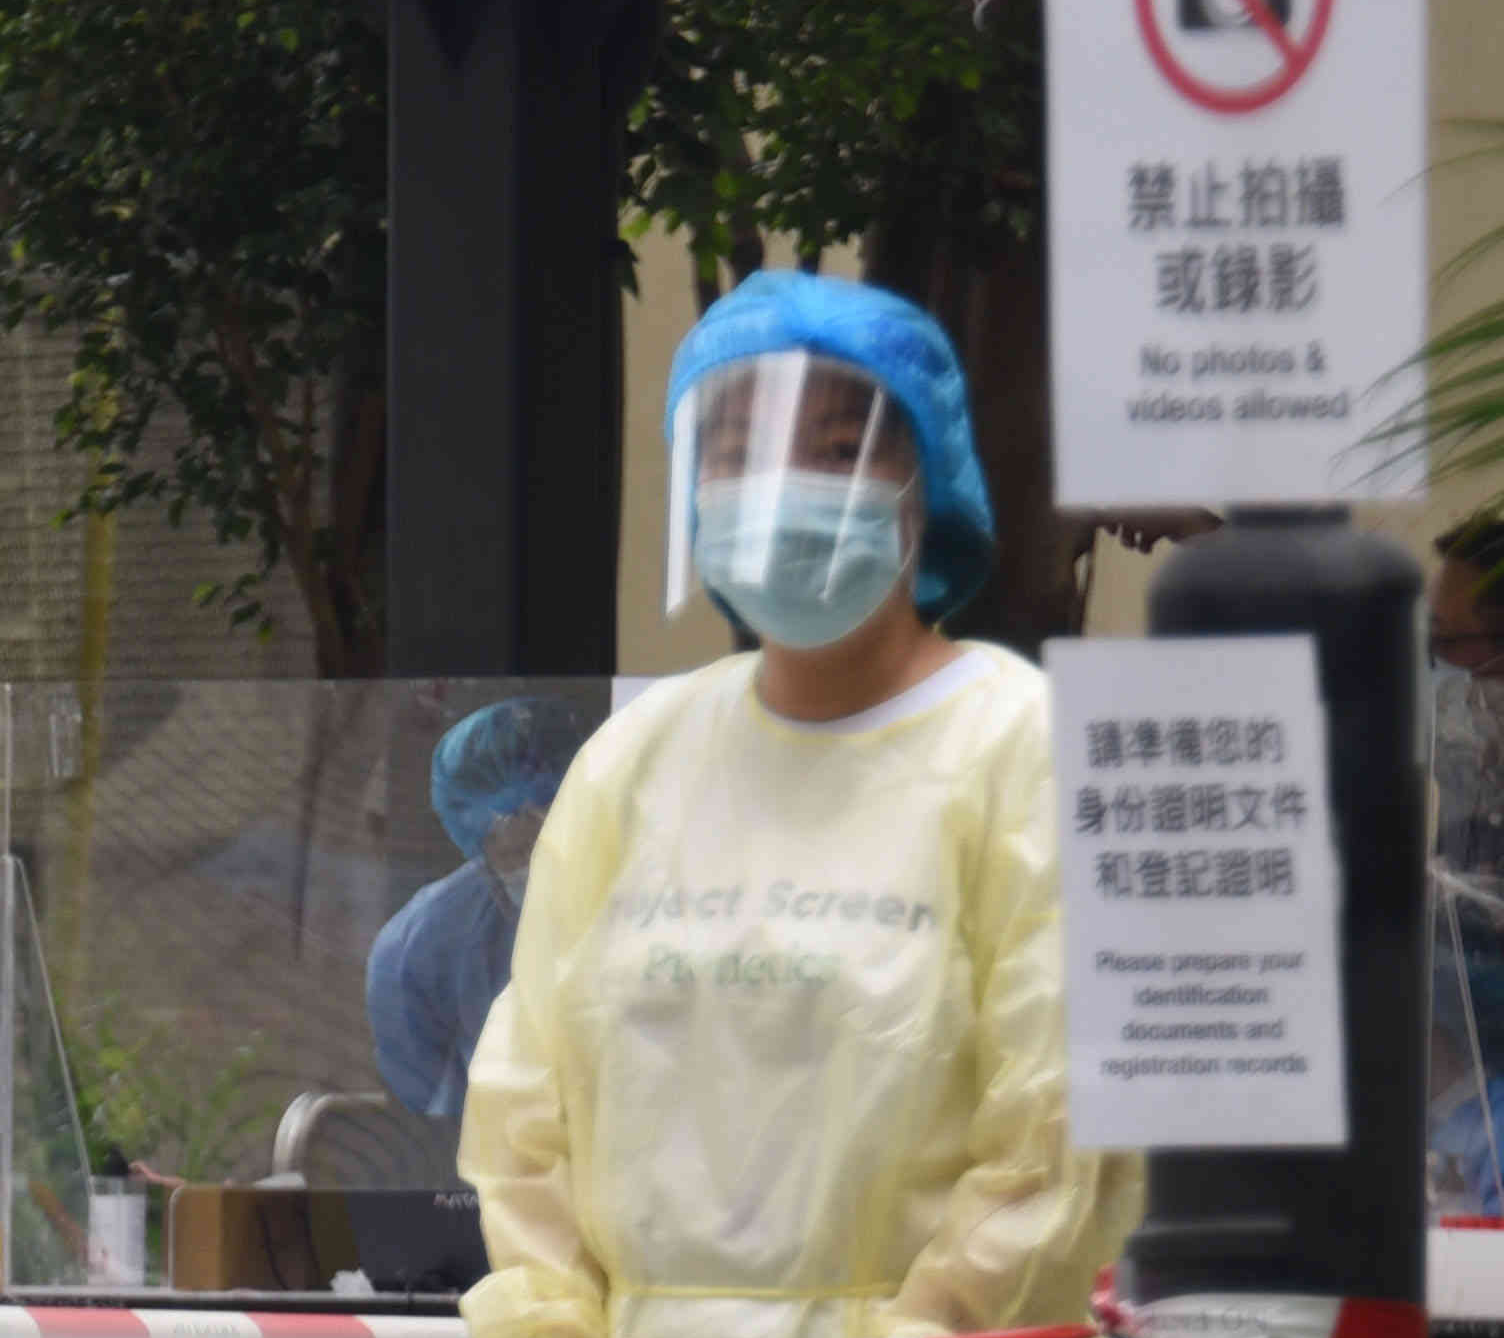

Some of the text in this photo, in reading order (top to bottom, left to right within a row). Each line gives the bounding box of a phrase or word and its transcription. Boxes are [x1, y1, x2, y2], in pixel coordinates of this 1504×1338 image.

[1126, 155, 1346, 231] 禁止拍攝
[1152, 244, 1318, 313] 或錄影
[1139, 343, 1182, 376] No
[1190, 342, 1297, 381] photos
[1127, 386, 1350, 424] videos allowed
[1095, 949, 1164, 973] Please
[1133, 982, 1269, 1006] identification
[1121, 1017, 1286, 1041] documents and
[1100, 1054, 1221, 1081] registration
